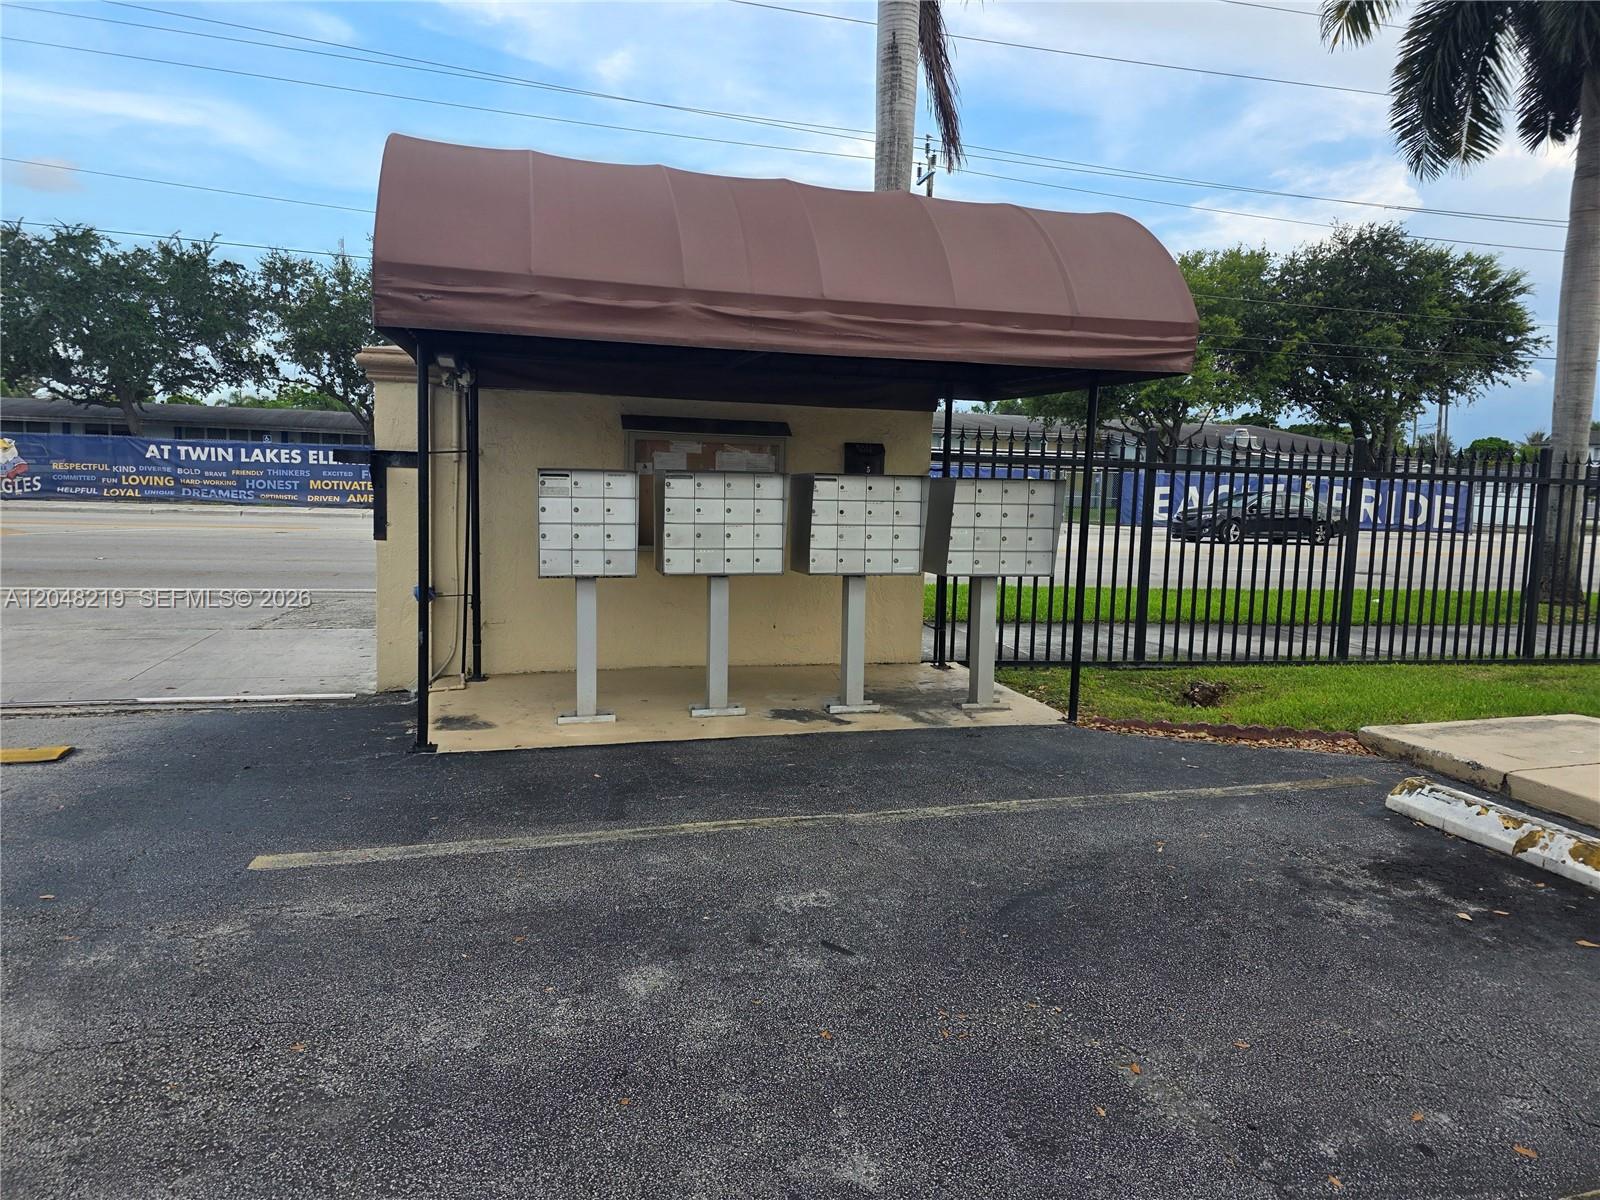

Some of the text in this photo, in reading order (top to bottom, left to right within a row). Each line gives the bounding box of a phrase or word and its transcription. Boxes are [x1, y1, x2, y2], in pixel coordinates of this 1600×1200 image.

[145, 444, 171, 460] AT
[177, 445, 233, 462] TWIN
[240, 448, 302, 464] LAKES
[52, 462, 110, 471] RESPECTFUL
[112, 465, 136, 473] KIND
[139, 465, 172, 473] DIVERSE
[177, 467, 201, 475] BOLD
[266, 468, 311, 477] THINKERS
[0, 476, 42, 494] GLES
[121, 475, 175, 486] LOVING
[180, 478, 237, 486] HARD-WORKING
[245, 480, 300, 490] HONEST
[56, 486, 98, 495] HELPFUL
[103, 488, 142, 497] LOYAL
[181, 488, 255, 500] DREAMERS
[260, 493, 299, 501] OPTIMISTIC
[307, 495, 340, 503] DRIVEN
